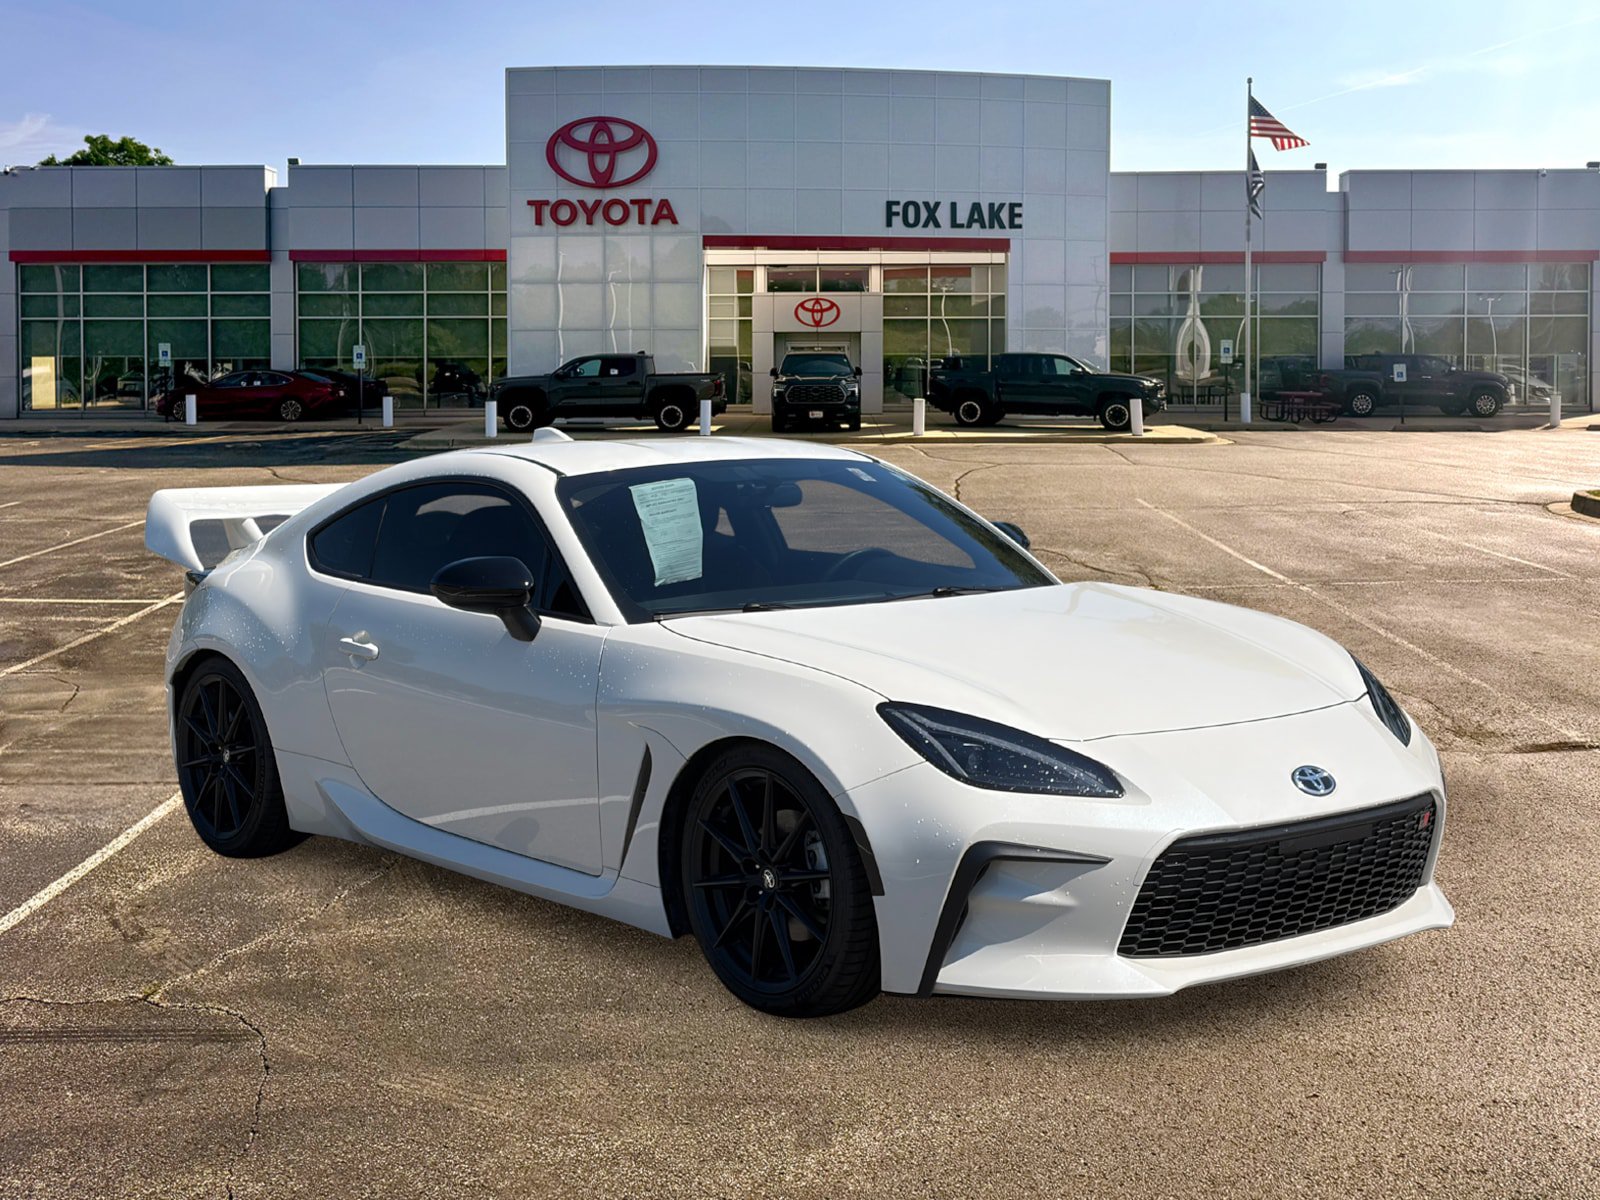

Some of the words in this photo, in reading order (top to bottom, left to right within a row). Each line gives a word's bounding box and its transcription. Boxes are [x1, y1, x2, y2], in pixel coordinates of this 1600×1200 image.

[527, 199, 679, 226] TOYOTA
[886, 200, 942, 228] FOX
[950, 201, 1023, 229] LAKE
